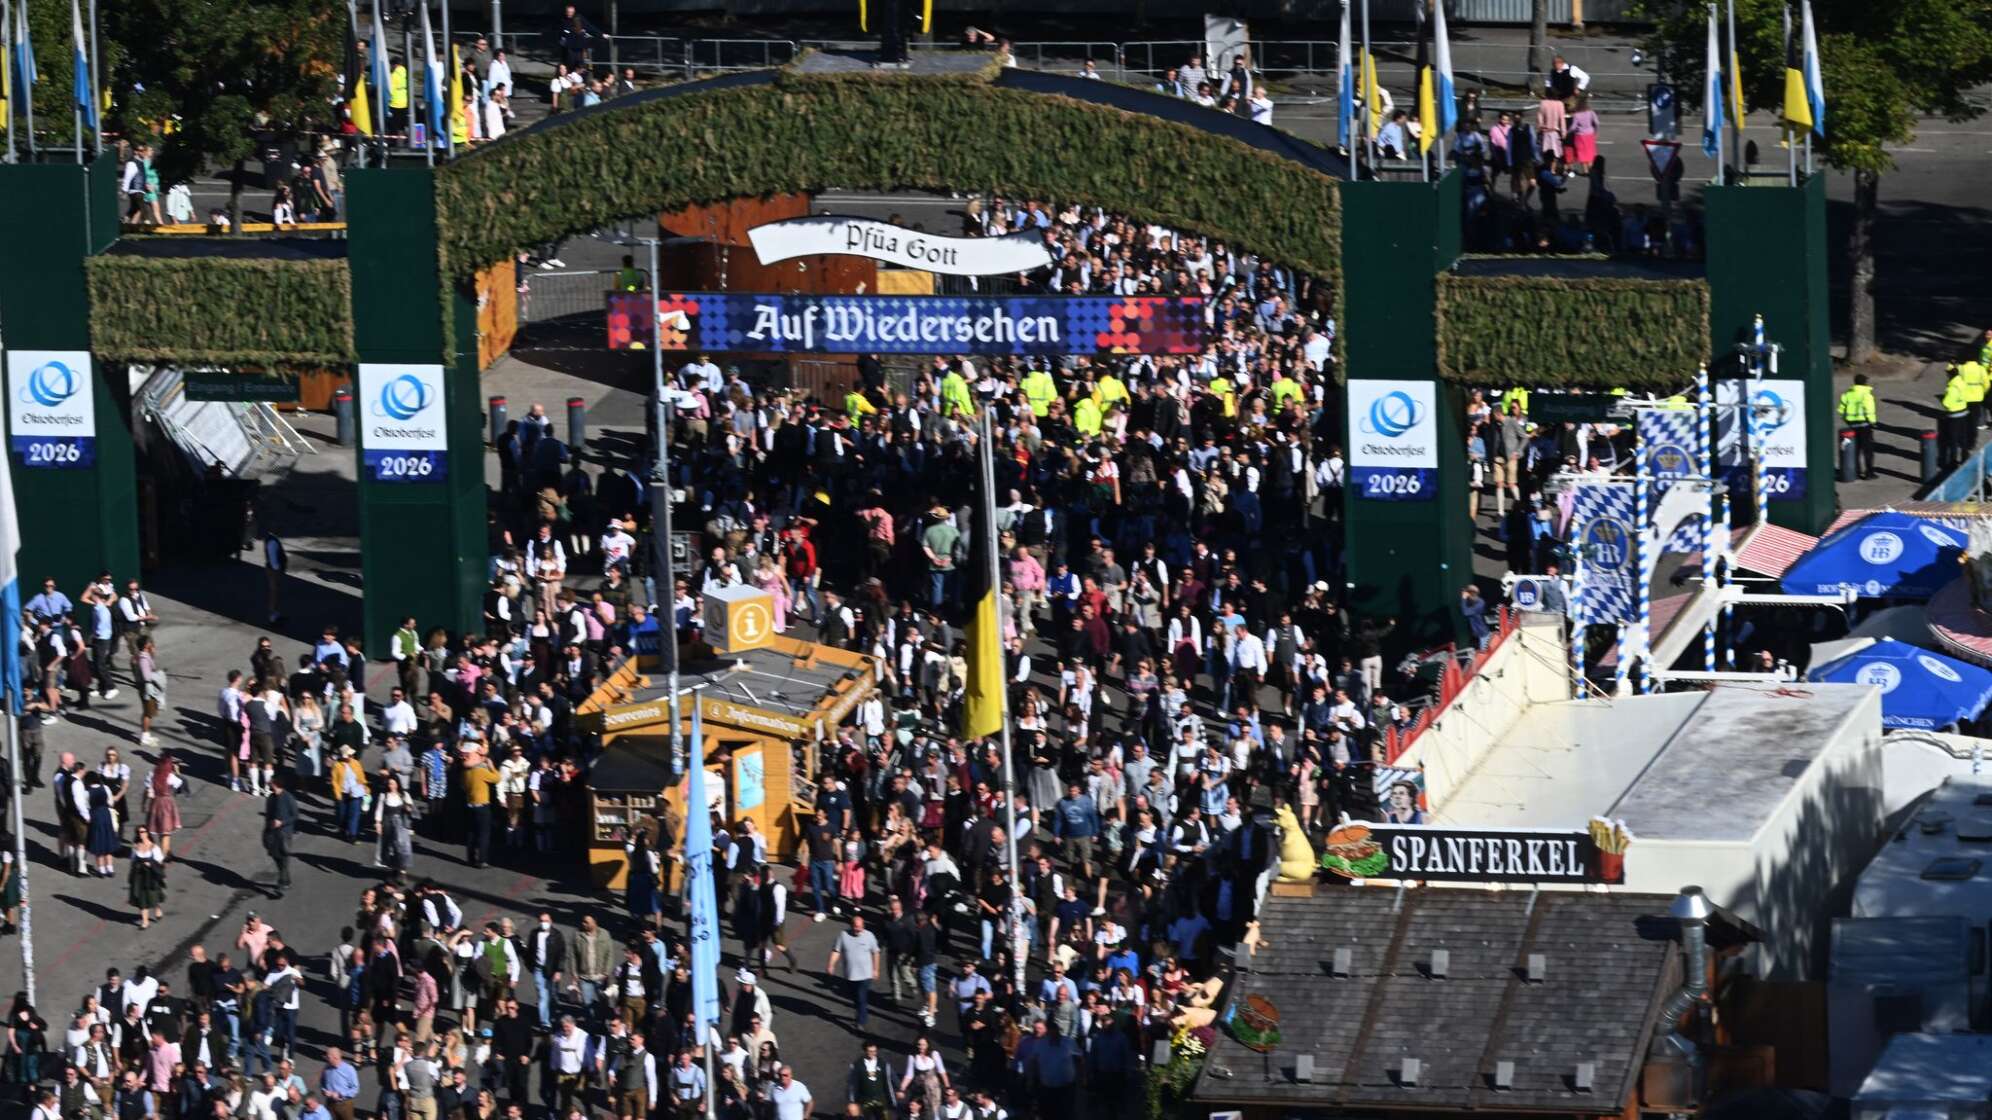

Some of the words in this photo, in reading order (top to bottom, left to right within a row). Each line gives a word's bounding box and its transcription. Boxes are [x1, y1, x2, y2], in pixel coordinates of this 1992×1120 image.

[906, 238, 958, 266] Gott
[746, 304, 818, 349] Auf
[825, 305, 1060, 343] Wiedersehen
[22, 412, 84, 427] Oktoberfest
[373, 426, 436, 440] Oktoberfest
[28, 443, 81, 462] 2026
[1360, 443, 1426, 458] Oktoberfest
[381, 457, 433, 476] 2026
[1368, 474, 1422, 494] 2026
[1391, 835, 1585, 877] SPANFERKEL
